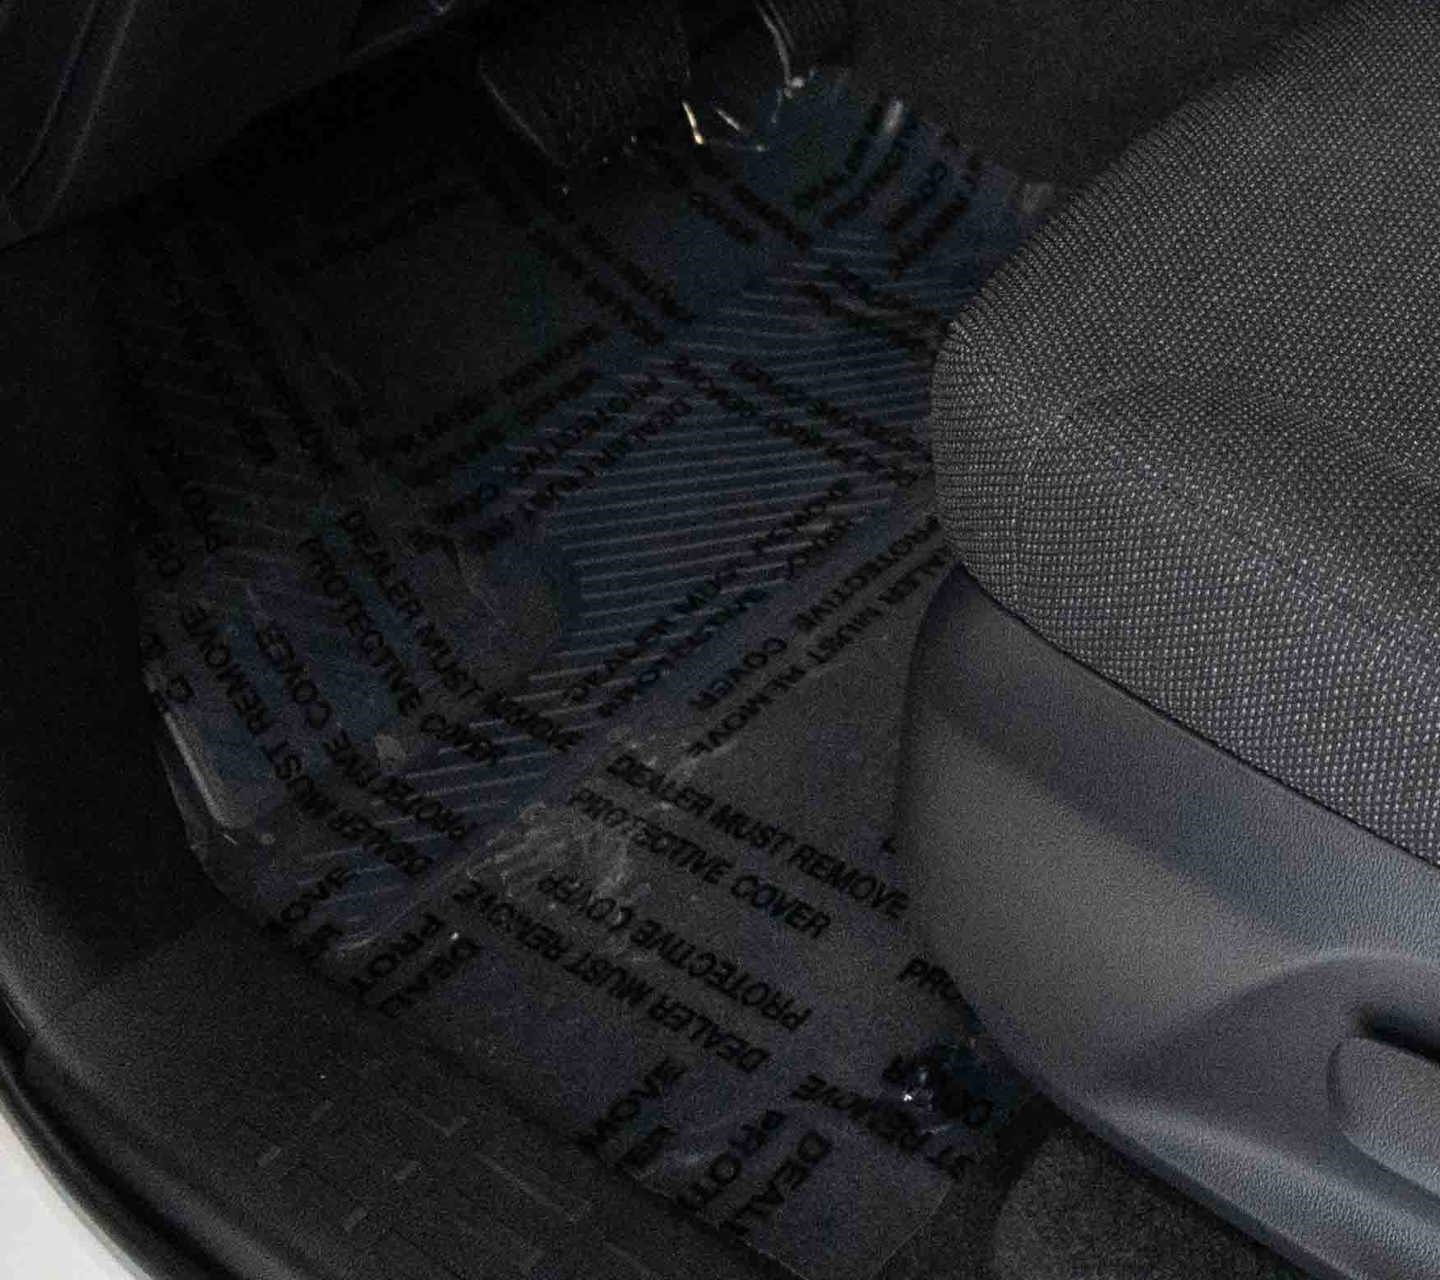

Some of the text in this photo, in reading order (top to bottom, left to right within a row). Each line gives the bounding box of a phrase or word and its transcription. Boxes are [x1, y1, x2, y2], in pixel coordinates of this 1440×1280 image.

[567, 788, 832, 939] PROTECTIVE COVER
[607, 754, 910, 920] DEALER MUST REMOVE
[563, 951, 655, 1007] MUST
[630, 919, 813, 1031] PROTECTIVE
[648, 996, 771, 1074] DEALER
